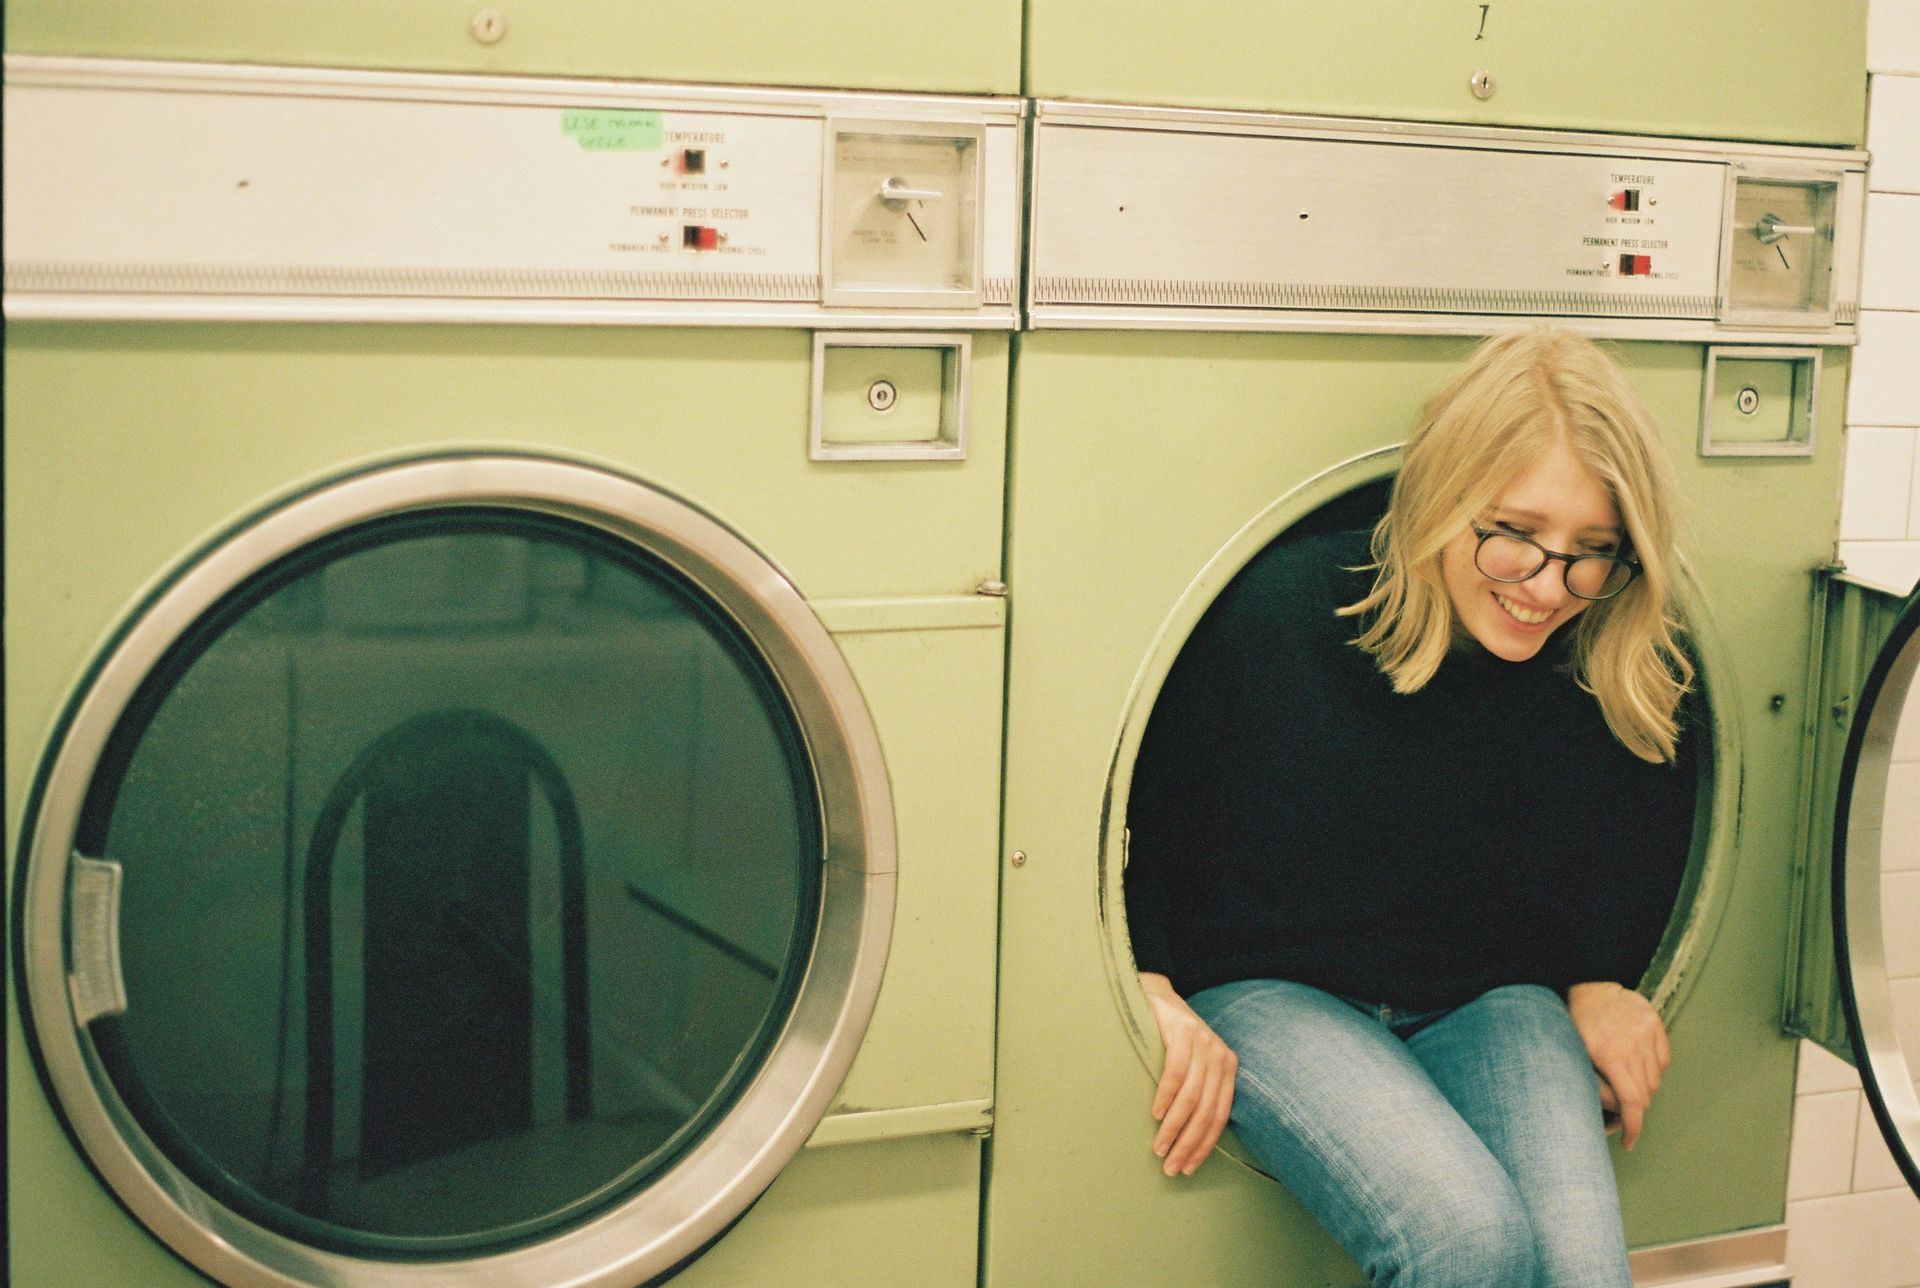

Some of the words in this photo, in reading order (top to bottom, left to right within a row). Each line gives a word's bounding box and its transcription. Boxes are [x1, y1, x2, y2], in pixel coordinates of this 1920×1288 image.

[665, 131, 726, 144] TEMPERATURE
[1610, 173, 1655, 185] TEMPERATURE
[630, 206, 677, 218] PERMANENT
[682, 207, 709, 218] PRESS
[711, 208, 749, 219] SELECTOR
[1582, 237, 1619, 248] PERMANENT
[1621, 239, 1639, 249] PRESS
[1640, 240, 1669, 250] SELECTOR
[1566, 269, 1595, 277] PERMANENT
